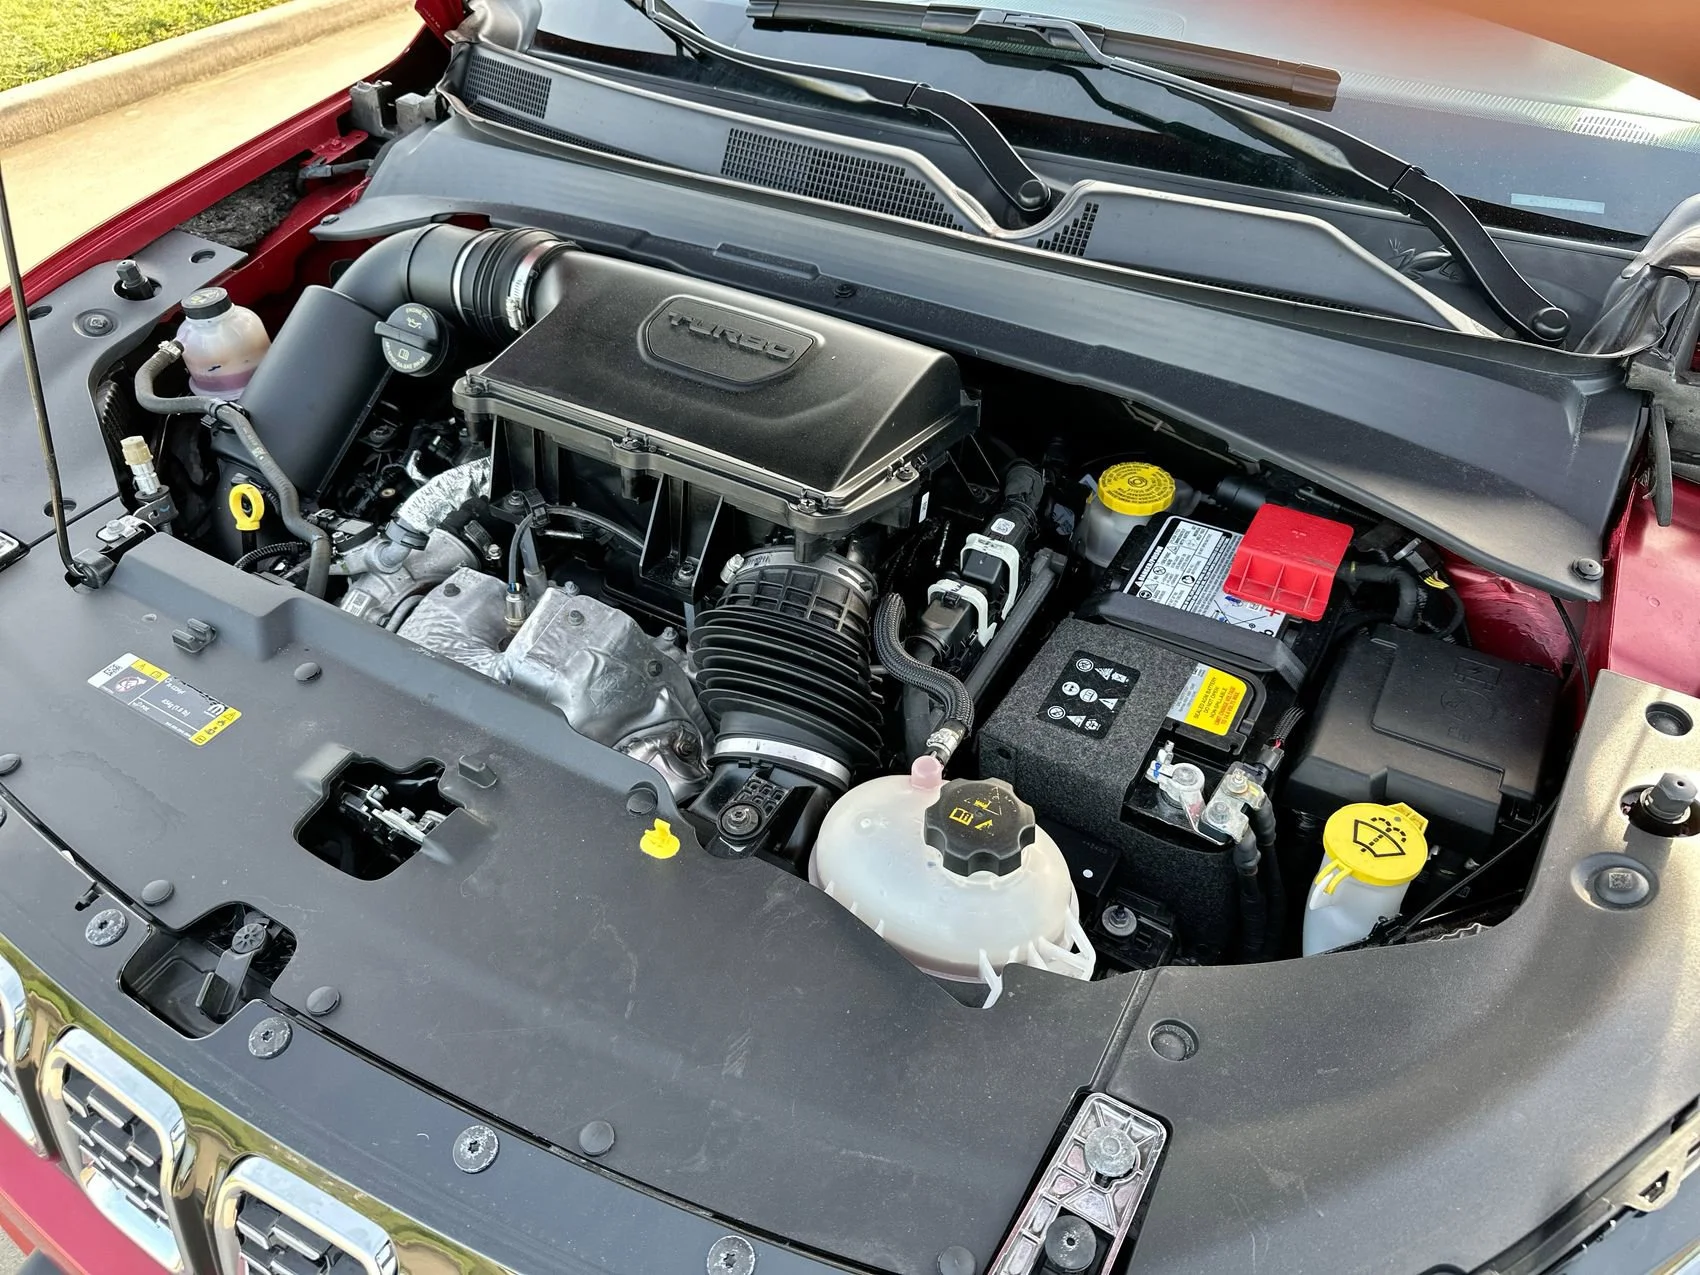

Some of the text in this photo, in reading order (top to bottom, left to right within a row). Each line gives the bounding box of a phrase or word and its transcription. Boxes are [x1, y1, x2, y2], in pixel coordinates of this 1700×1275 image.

[668, 312, 795, 360] TURBO
[1205, 677, 1217, 694] BATTERY
[1203, 706, 1209, 714] DO
[1210, 686, 1219, 699] OPEN
